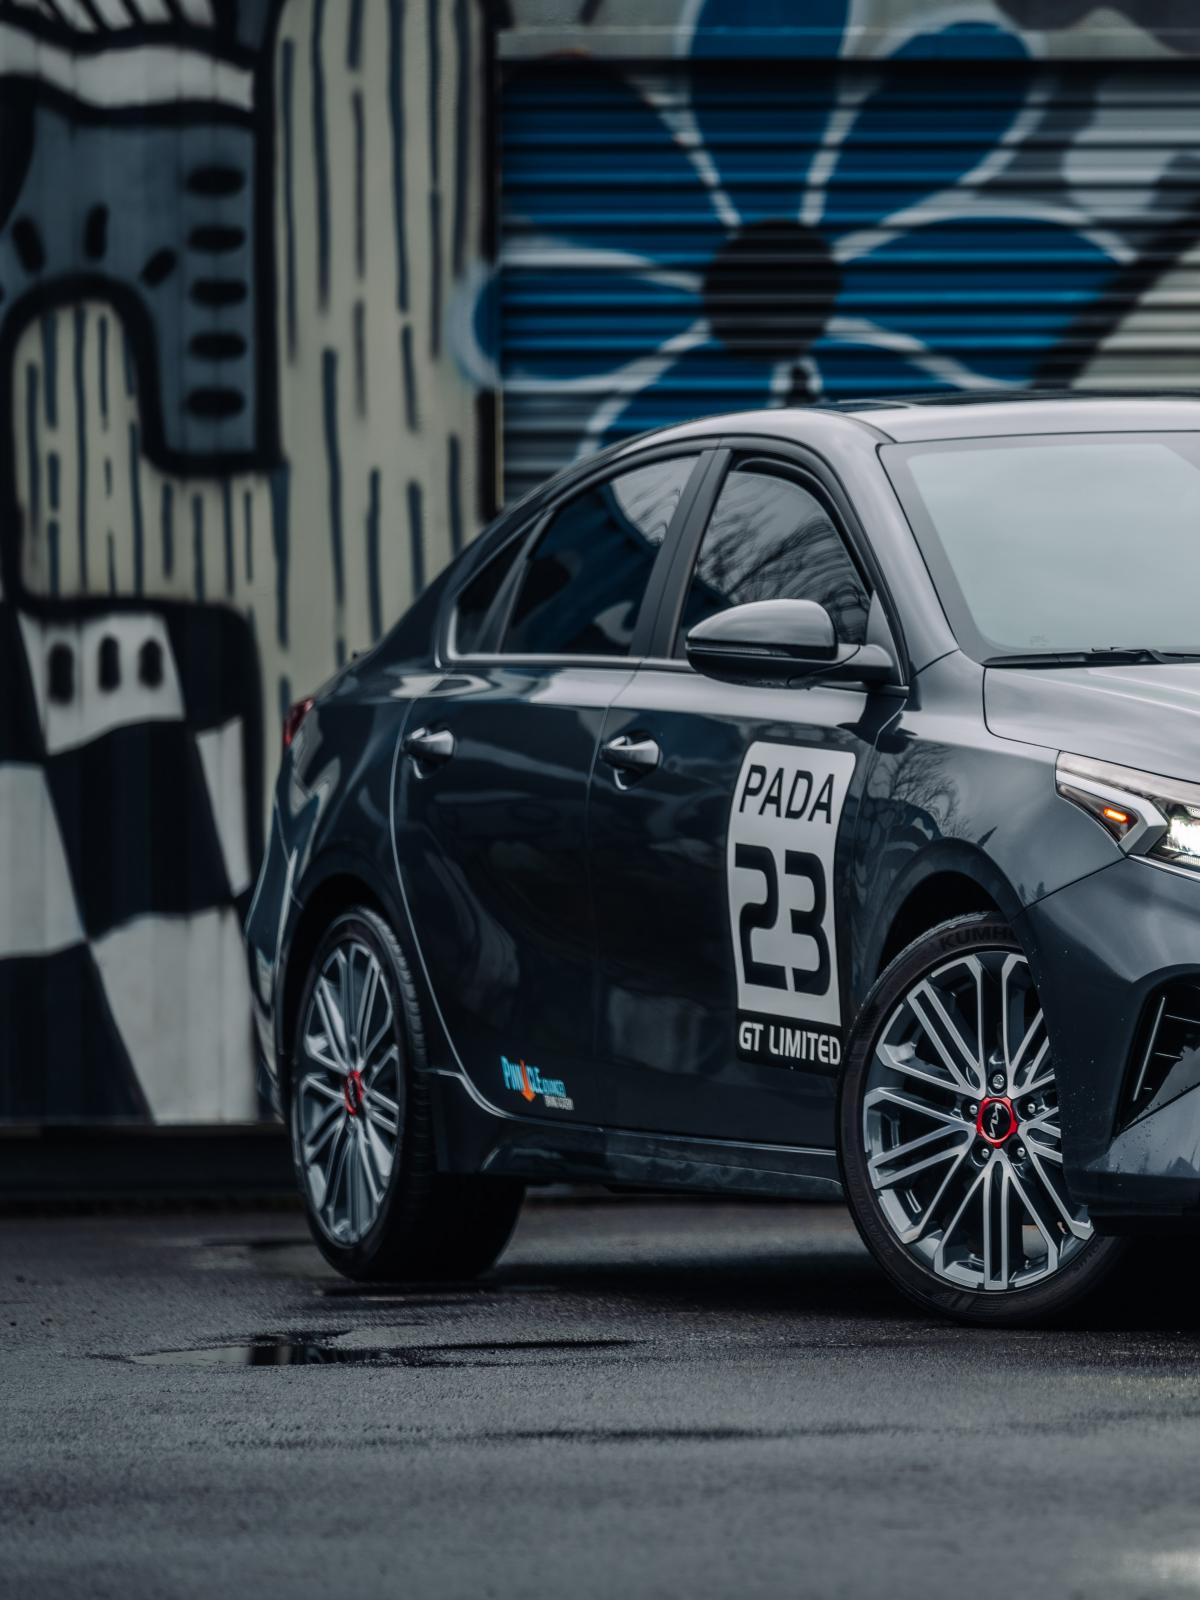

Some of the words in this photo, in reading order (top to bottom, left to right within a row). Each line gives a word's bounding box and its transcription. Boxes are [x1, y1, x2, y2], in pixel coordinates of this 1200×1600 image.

[739, 764, 835, 824] PADA
[735, 842, 831, 996] 23
[739, 1021, 764, 1051] GT
[769, 1026, 841, 1065] LIMITED
